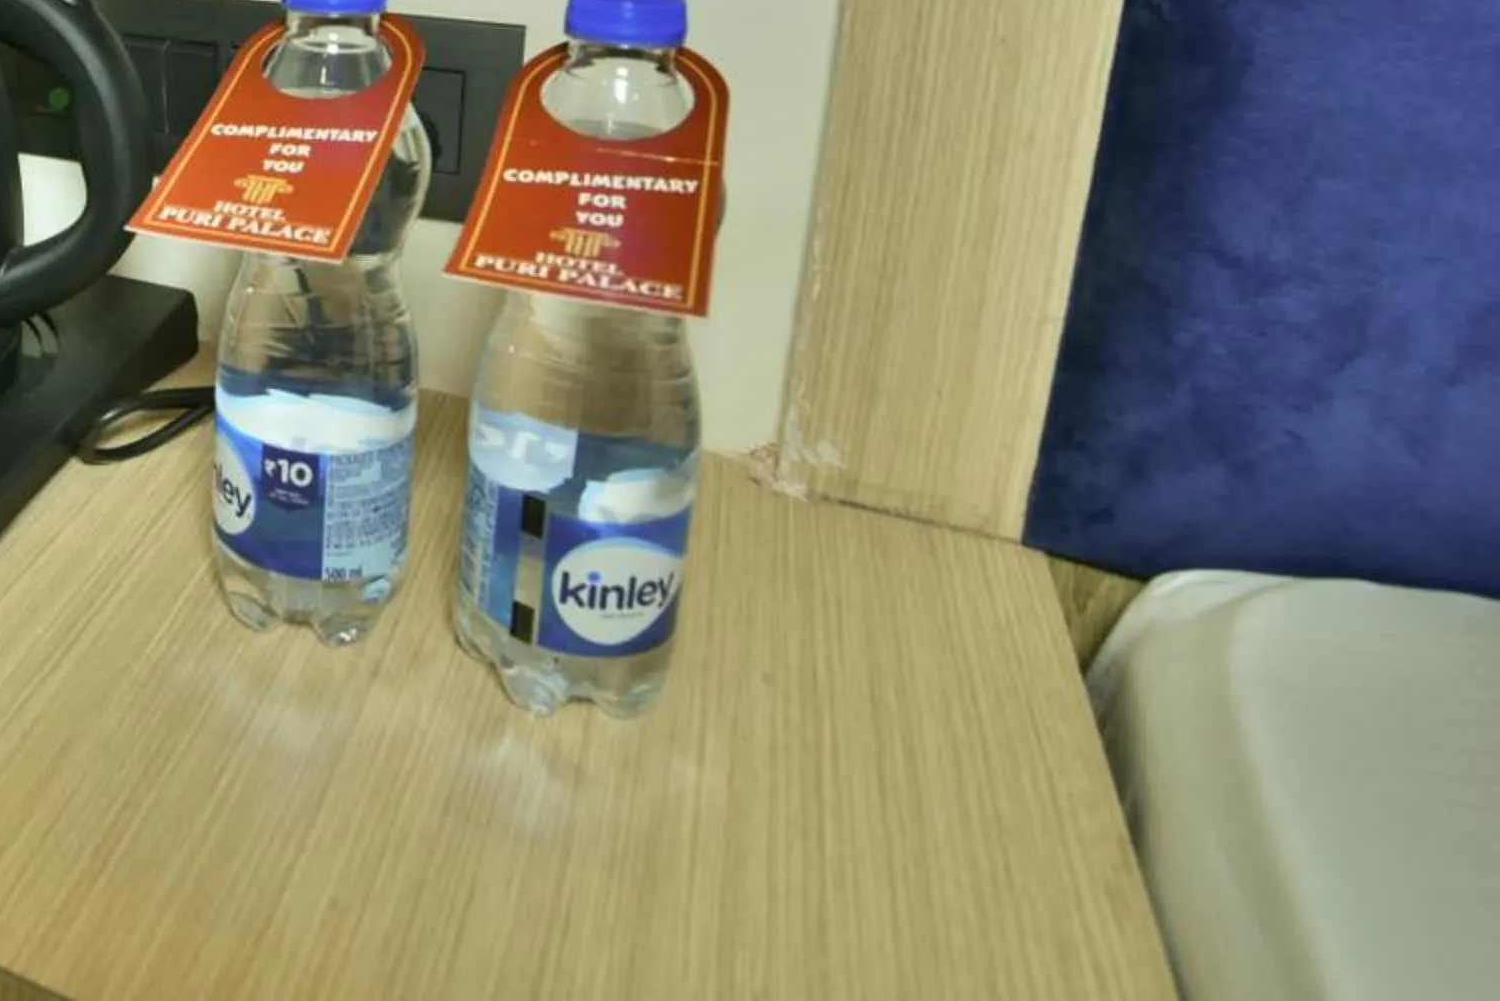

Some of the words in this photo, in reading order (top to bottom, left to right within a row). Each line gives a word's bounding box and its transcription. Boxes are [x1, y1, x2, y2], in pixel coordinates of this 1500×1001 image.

[210, 123, 379, 144] COMPLIMENTARY
[269, 142, 312, 157] FOR
[262, 159, 304, 173] YOU
[502, 168, 698, 194] COMPLIMENTARY
[213, 200, 287, 222] HOTEL
[577, 192, 627, 209] FOR
[159, 205, 222, 229] PURI
[226, 215, 332, 245] PALACE
[575, 211, 624, 227] YOU
[535, 251, 624, 276] HOTEL
[475, 253, 549, 279] PURI
[558, 268, 684, 300] PALACE
[558, 570, 675, 610] kinley
